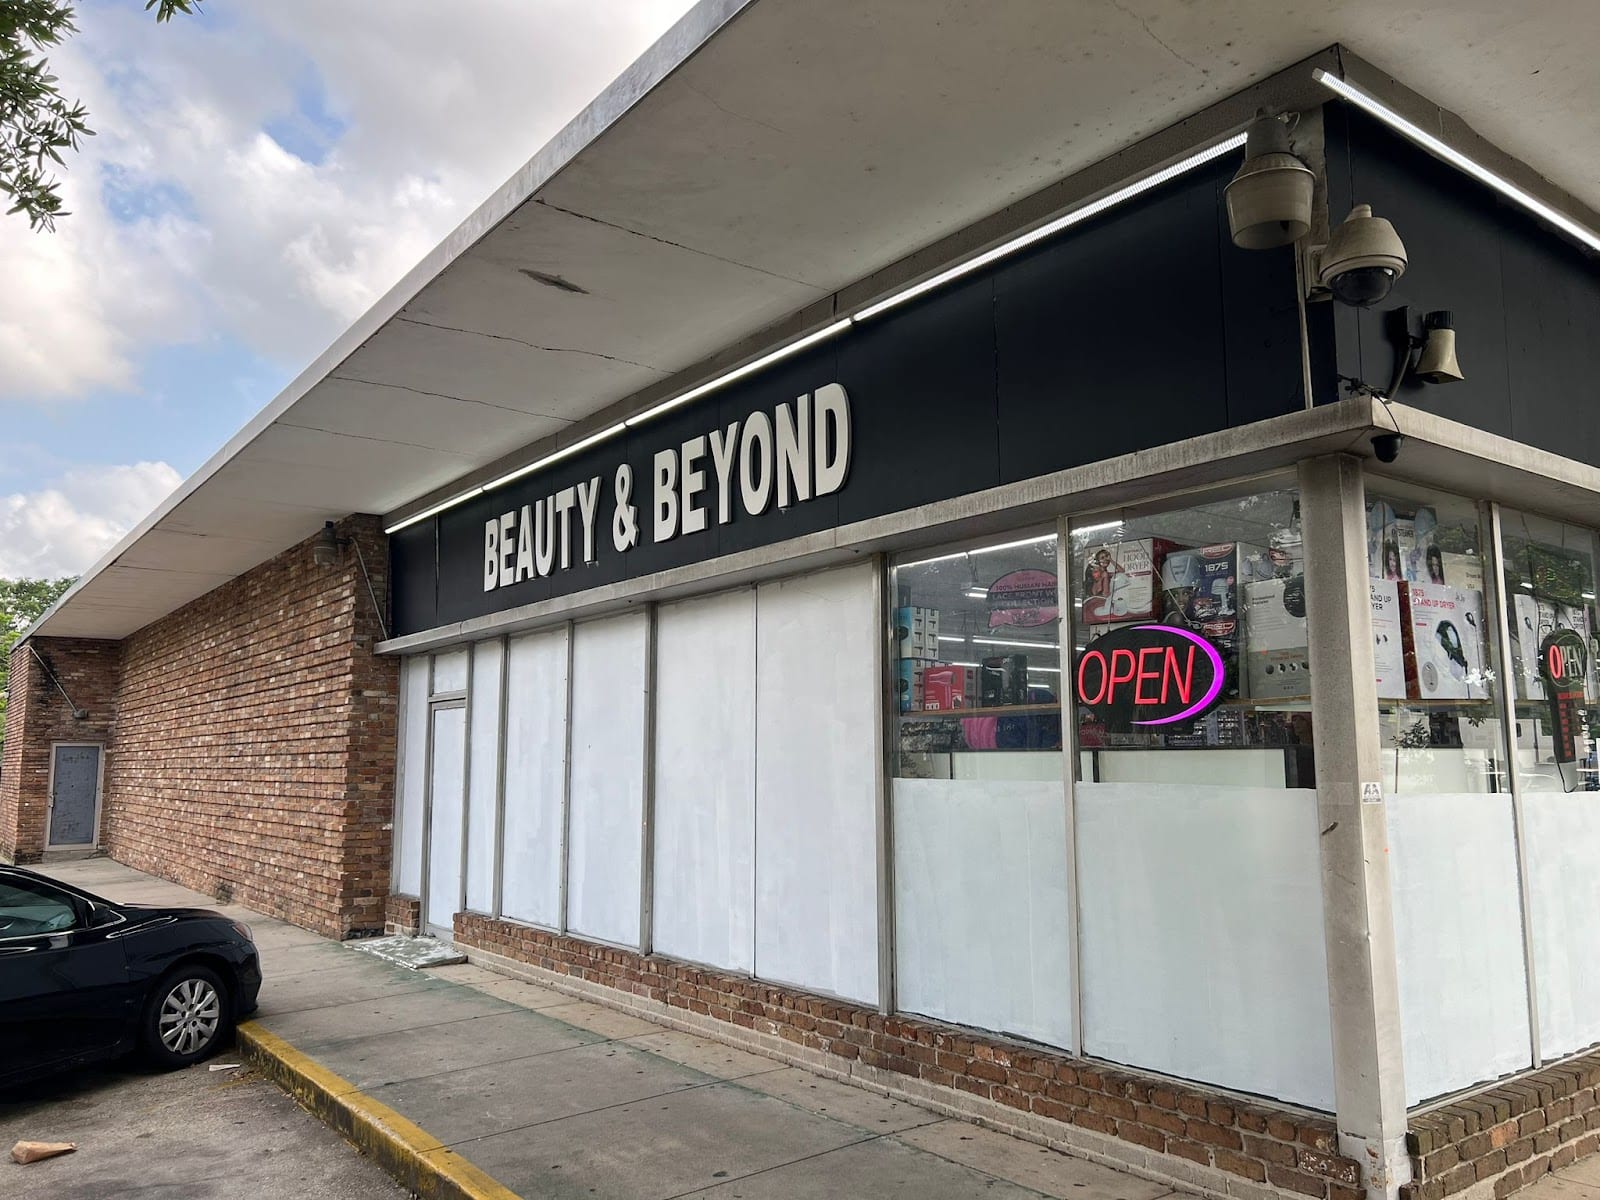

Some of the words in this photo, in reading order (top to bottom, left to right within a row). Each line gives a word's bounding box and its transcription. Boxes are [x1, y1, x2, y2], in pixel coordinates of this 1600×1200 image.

[484, 475, 602, 592] BEAUTY
[613, 463, 639, 552] &
[653, 382, 852, 543] BEYOND
[1205, 562, 1228, 572] 1875
[1078, 645, 1196, 706] OPEN
[1549, 644, 1584, 680] OPEN
